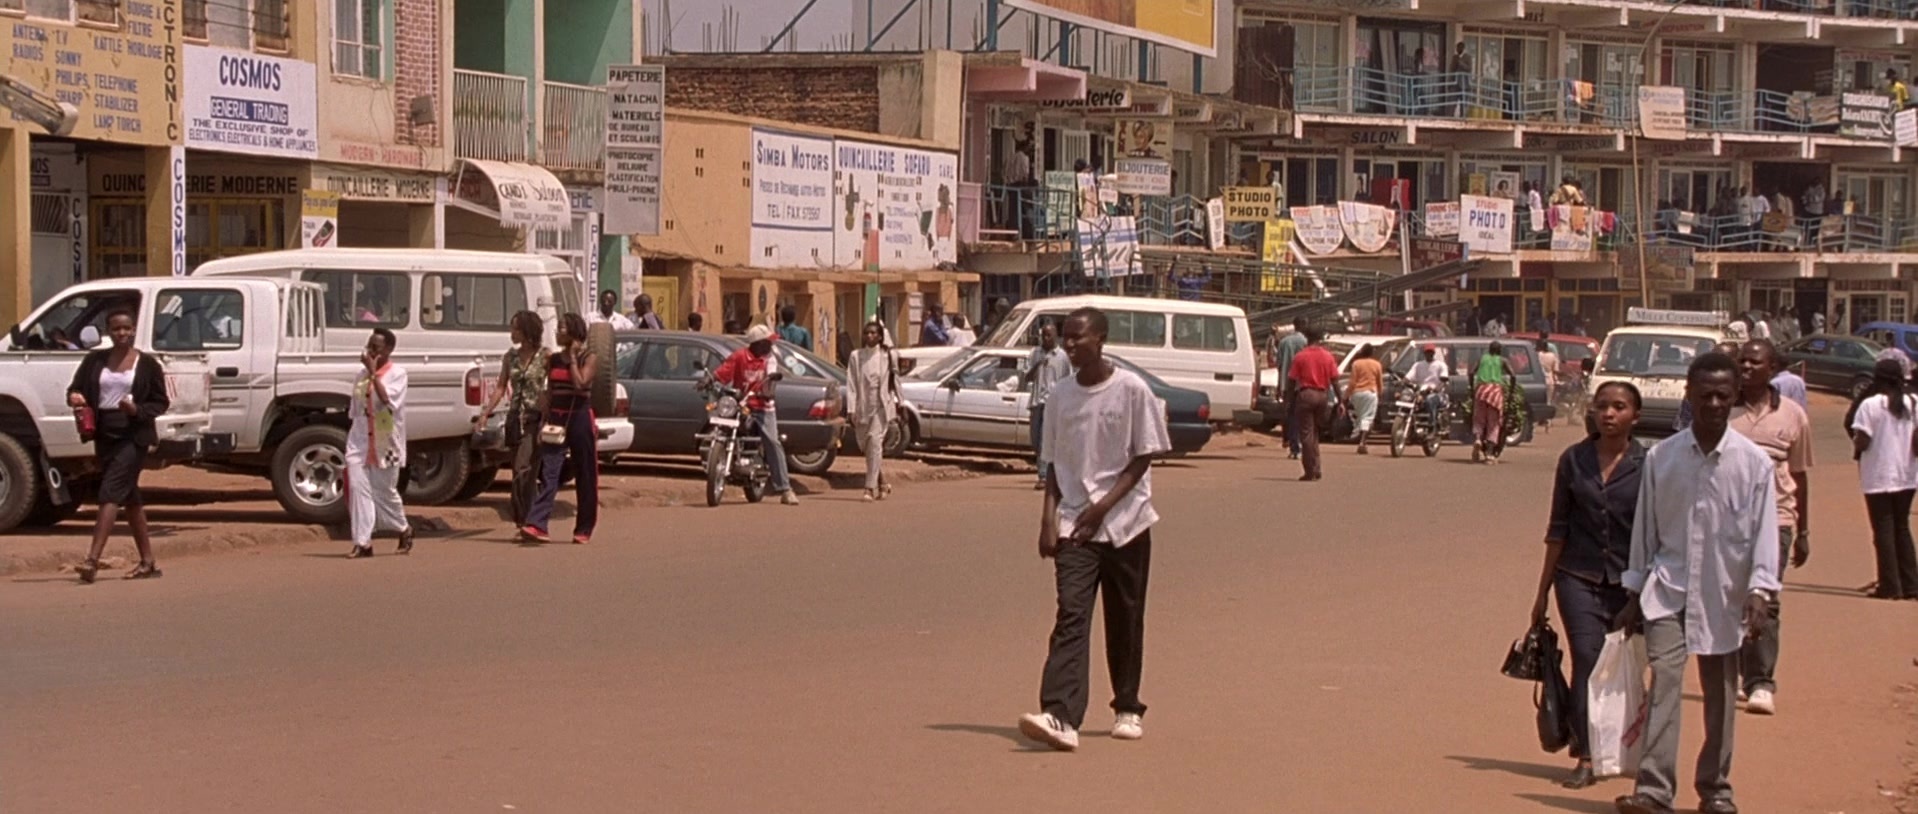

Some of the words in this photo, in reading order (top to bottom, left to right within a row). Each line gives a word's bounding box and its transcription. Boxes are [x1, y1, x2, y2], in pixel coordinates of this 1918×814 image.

[127, 20, 153, 38] FILTRE
[219, 55, 281, 91] COSMOS
[94, 73, 138, 94] TELEPHONE
[94, 93, 139, 113] STABILIZER
[614, 94, 658, 104] NATACHA
[211, 99, 250, 119] GENERAL
[252, 103, 288, 124] TRADING
[612, 111, 660, 121] MATERIELS
[94, 114, 114, 129] LAMP
[117, 116, 142, 133] TORCH
[193, 118, 212, 128] THE
[215, 120, 266, 133] EXCLUSIVE
[270, 126, 294, 136] SHOP
[296, 129, 309, 137] OF
[608, 123, 619, 132] DE
[621, 123, 650, 133] BUREAU
[189, 128, 226, 143] ELECTRONICS
[227, 132, 262, 147] ELECTRICALS
[269, 137, 284, 149] HOME
[608, 134, 618, 143] ET
[620, 135, 660, 144] SCOLAIRES
[1351, 130, 1400, 144] SALON
[617, 162, 648, 171] RELIURE
[839, 146, 895, 173] QUINCAILLERIE
[1117, 161, 1170, 177] BIJOUTERIE
[222, 175, 297, 194] MODERNE
[327, 175, 389, 198] QUINCAILLERIE
[1228, 191, 1271, 204] STUDIO
[174, 159, 185, 276] COSMO
[768, 203, 780, 218] TEL
[787, 205, 800, 220] FAX
[1230, 206, 1269, 217] PHOTO
[1469, 210, 1506, 229] PHOTO
[72, 198, 82, 284] COSM
[1478, 231, 1495, 240] IDEAL
[588, 224, 598, 312] PAPET
